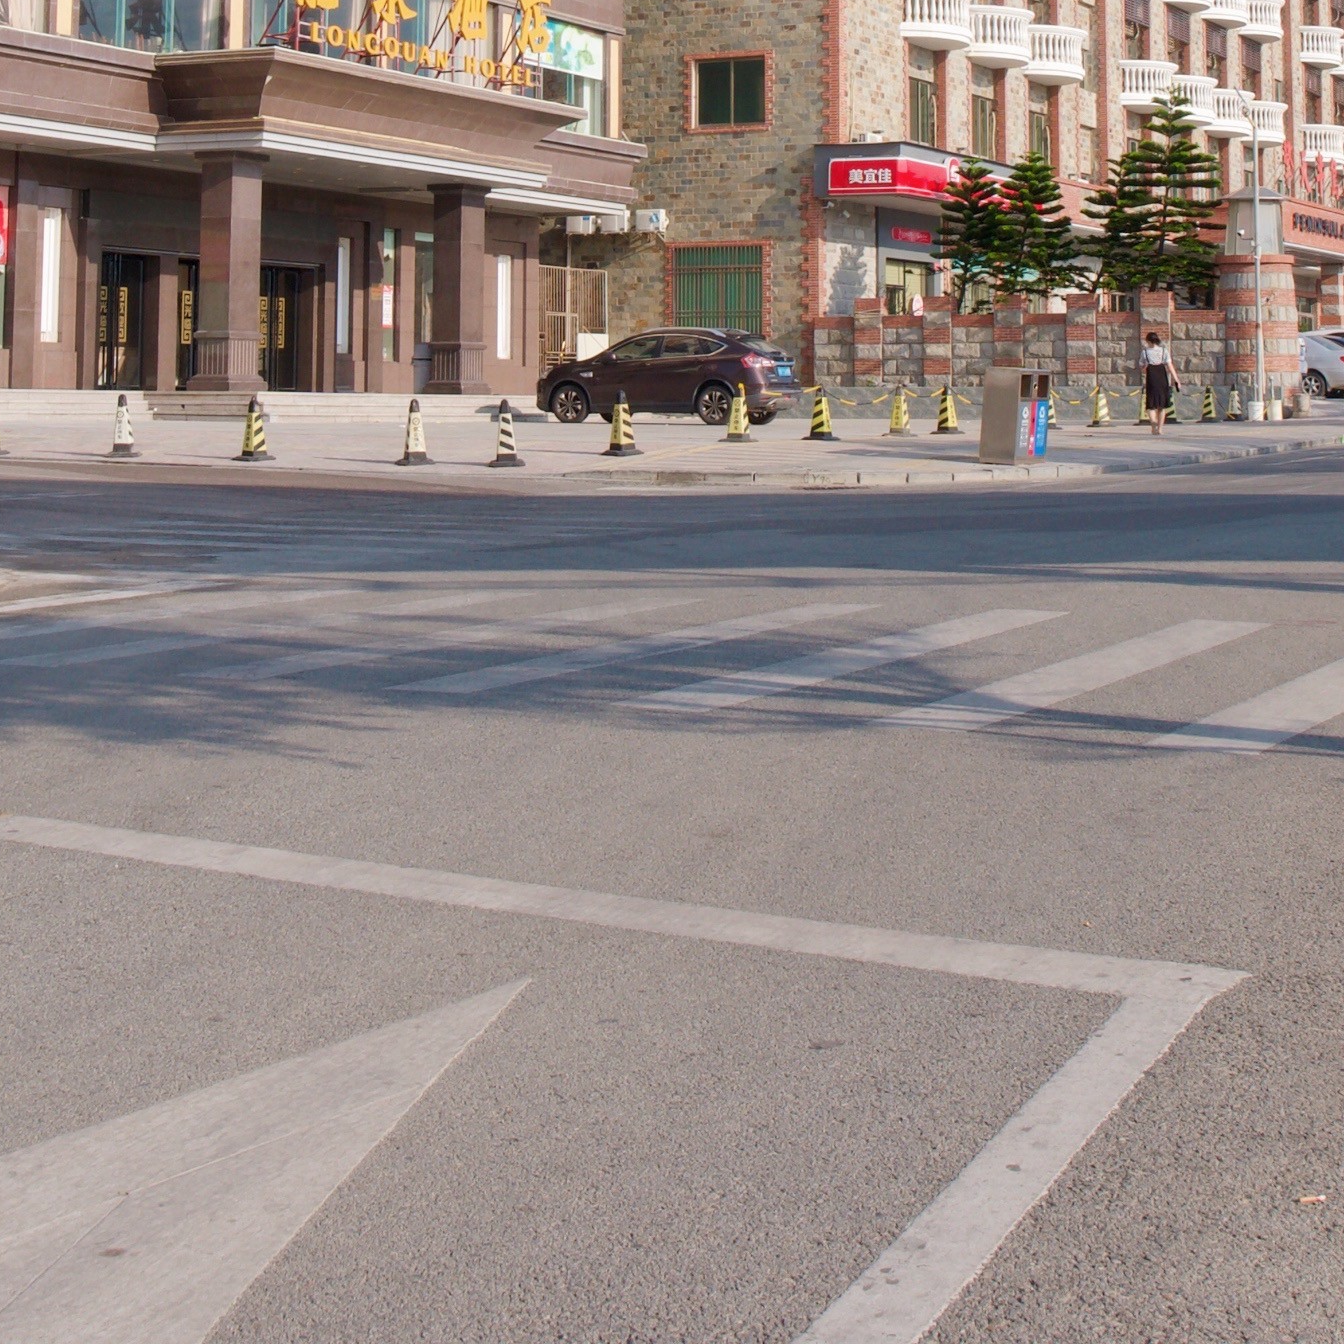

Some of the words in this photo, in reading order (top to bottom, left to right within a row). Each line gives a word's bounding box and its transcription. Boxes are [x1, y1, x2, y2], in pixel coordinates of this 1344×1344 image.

[309, 22, 453, 70] LONGQUAN
[464, 54, 538, 88] HOTEL
[847, 167, 893, 185] 美宜佳
